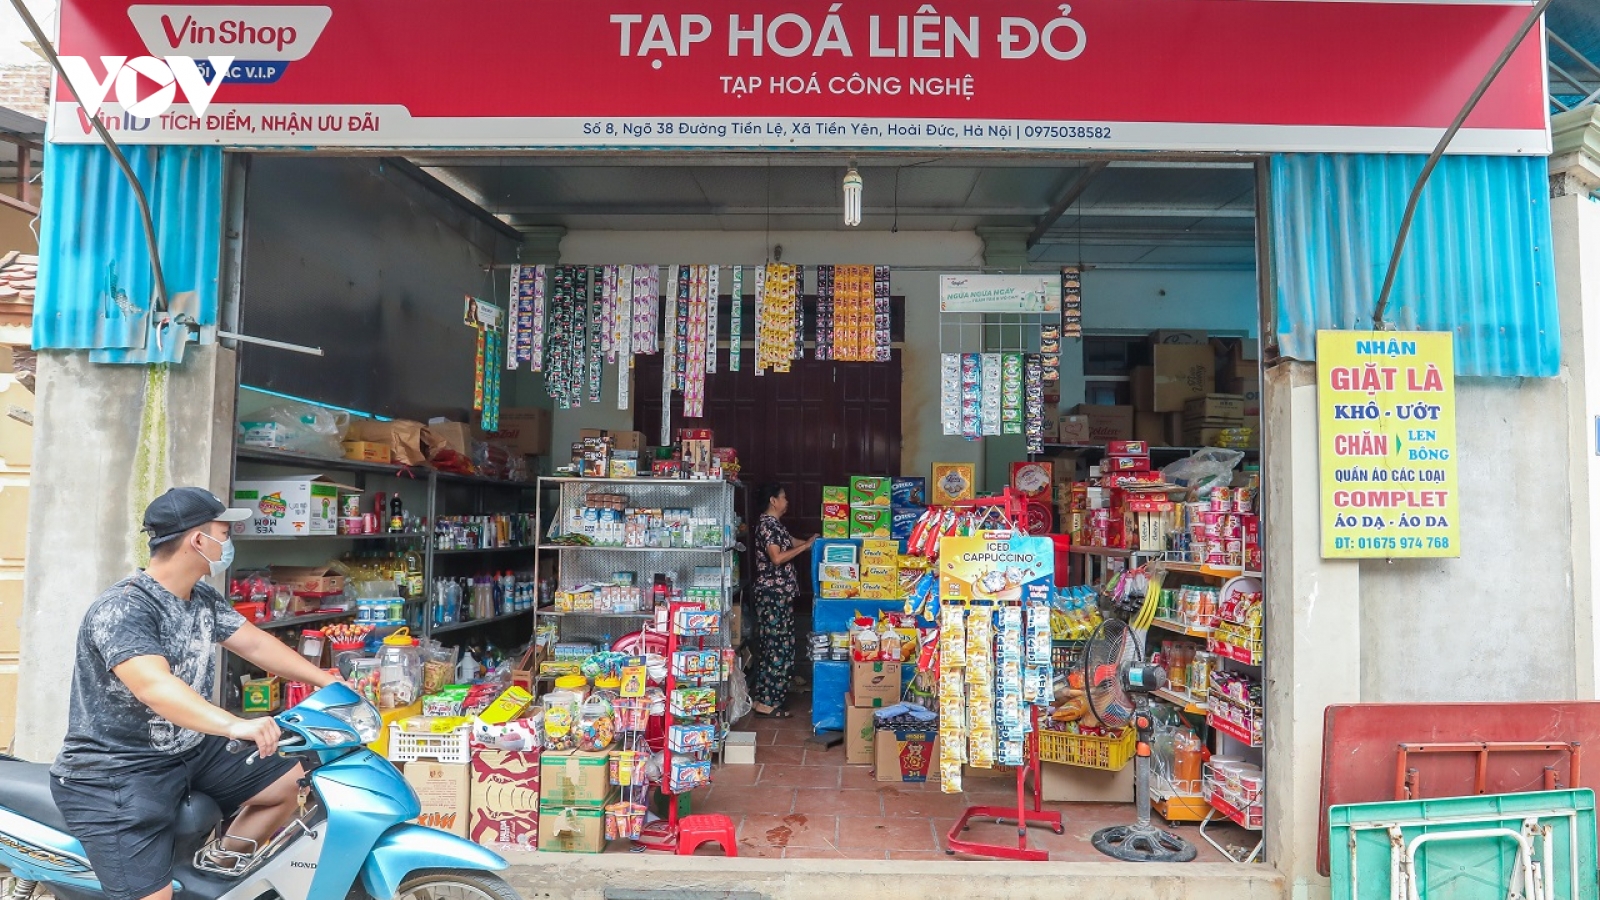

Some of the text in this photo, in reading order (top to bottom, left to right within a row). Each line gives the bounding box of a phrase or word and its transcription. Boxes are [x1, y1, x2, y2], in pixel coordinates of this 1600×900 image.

[160, 14, 297, 52] VinShop
[609, 3, 1087, 70] TẠP HOÁ LIÊN ĐỎ
[720, 72, 975, 101] TẠP HOÁ CÔNG NGHỆ
[159, 111, 200, 131] TÍCH
[206, 109, 256, 133] ĐIỂM,
[261, 112, 312, 135] NHẬN
[318, 114, 343, 132] ƯU
[347, 112, 380, 132] ĐÃI
[583, 121, 601, 134] Số
[605, 122, 617, 136] 8,
[623, 122, 652, 137] Ngõ
[656, 122, 674, 134] 38
[678, 121, 727, 137] Đường
[767, 121, 787, 137] Lệ,
[792, 122, 811, 134] Xã
[851, 122, 882, 137] Yên,
[888, 124, 921, 136] Hoài
[926, 123, 958, 138] Đức,
[964, 123, 983, 137] Hà
[989, 124, 1012, 138] Nội
[1024, 125, 1112, 139] 0975038582
[1356, 338, 1416, 358] NHẬN
[1331, 363, 1444, 395] GIẶT LÀ
[1334, 401, 1380, 419] KHÔ
[1396, 402, 1441, 420] ƯỚT
[1334, 430, 1388, 456] CHĂN
[1408, 430, 1437, 441] LEN
[1408, 446, 1450, 460] BÔNG
[1372, 466, 1388, 482] ÁO
[1391, 466, 1416, 482] CÁC
[1419, 469, 1445, 485] LOẠI
[1333, 491, 1448, 508] COMPLET
[1335, 512, 1358, 528] ÁO
[1362, 515, 1386, 531] DẠ
[1398, 512, 1421, 528] ÁO
[1425, 515, 1449, 528] DA
[986, 543, 1010, 552] ICED
[1335, 536, 1450, 549] ĐT: 01675 974 768
[963, 553, 1034, 563] CAPPUCCINO
[290, 860, 318, 869] HOND
